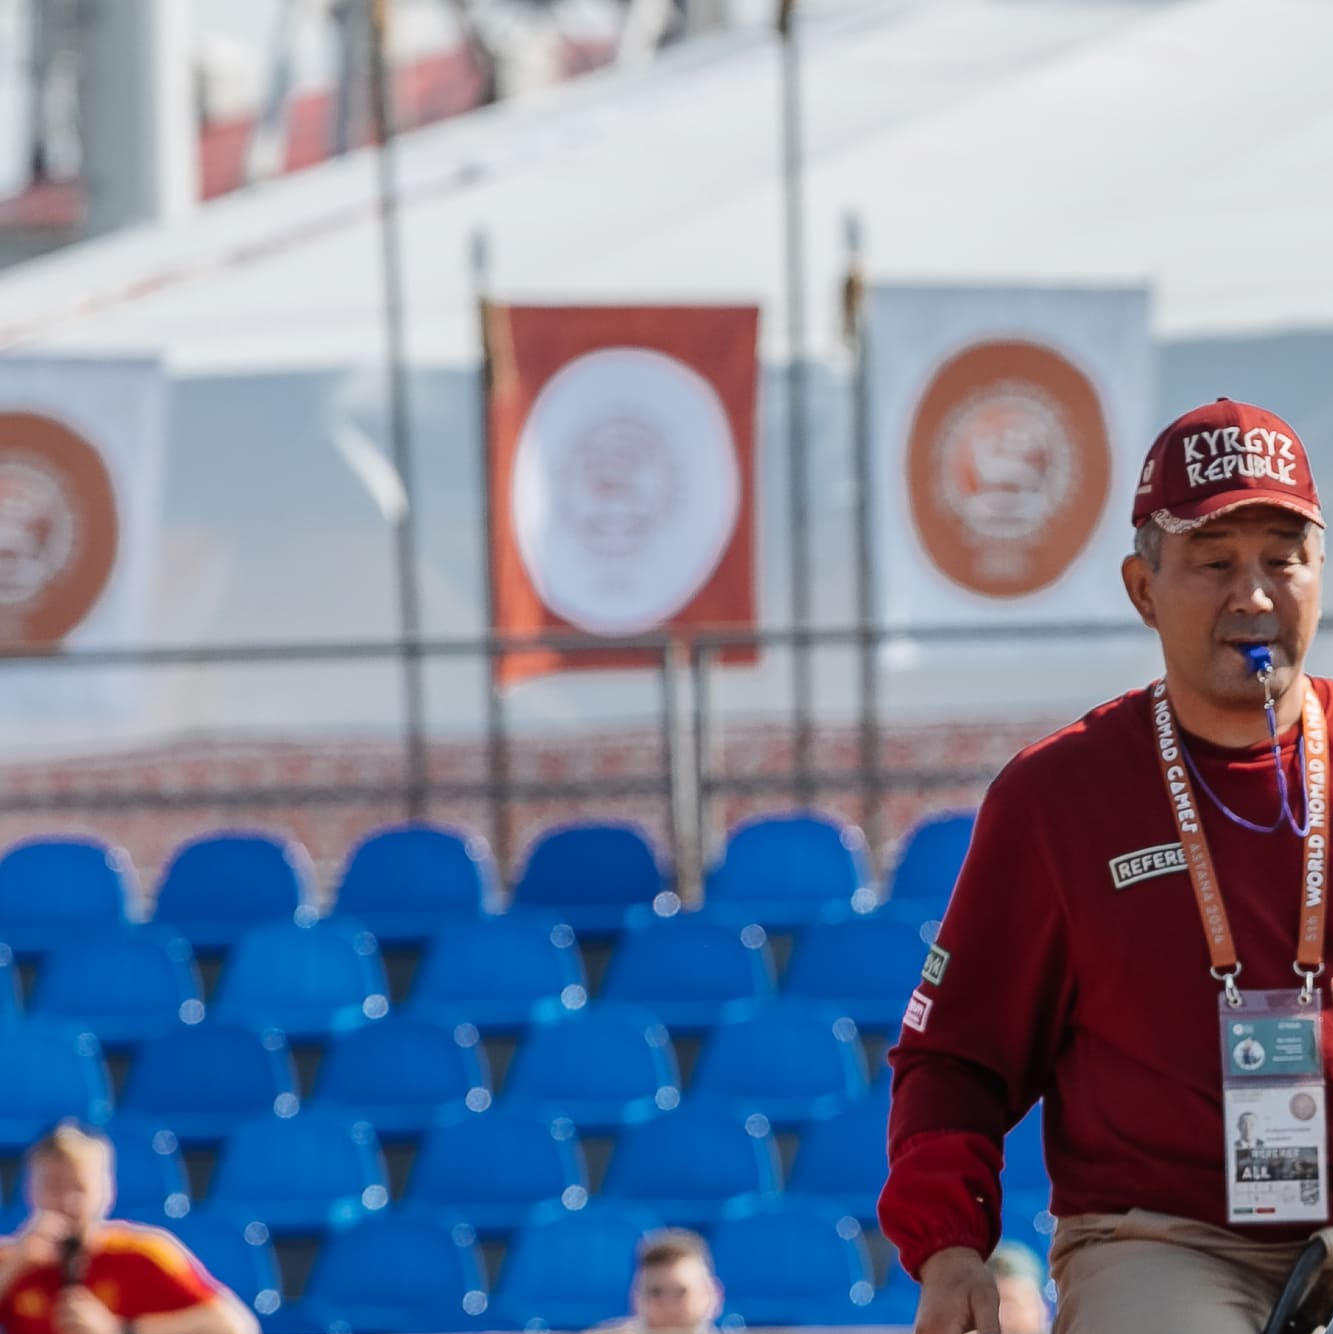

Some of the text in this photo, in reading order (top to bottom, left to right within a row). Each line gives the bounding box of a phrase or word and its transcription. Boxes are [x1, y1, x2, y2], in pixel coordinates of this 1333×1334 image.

[1183, 426, 1296, 463] KYRGYZ
[1153, 698, 1179, 762] NOMAD
[1167, 765, 1199, 833] GAMES
[1189, 843, 1214, 902] ASTANA
[1206, 904, 1224, 945] 2024
[1308, 758, 1326, 828] NOMAD
[1118, 848, 1186, 879] REFERE
[1306, 834, 1326, 908] WORLD
